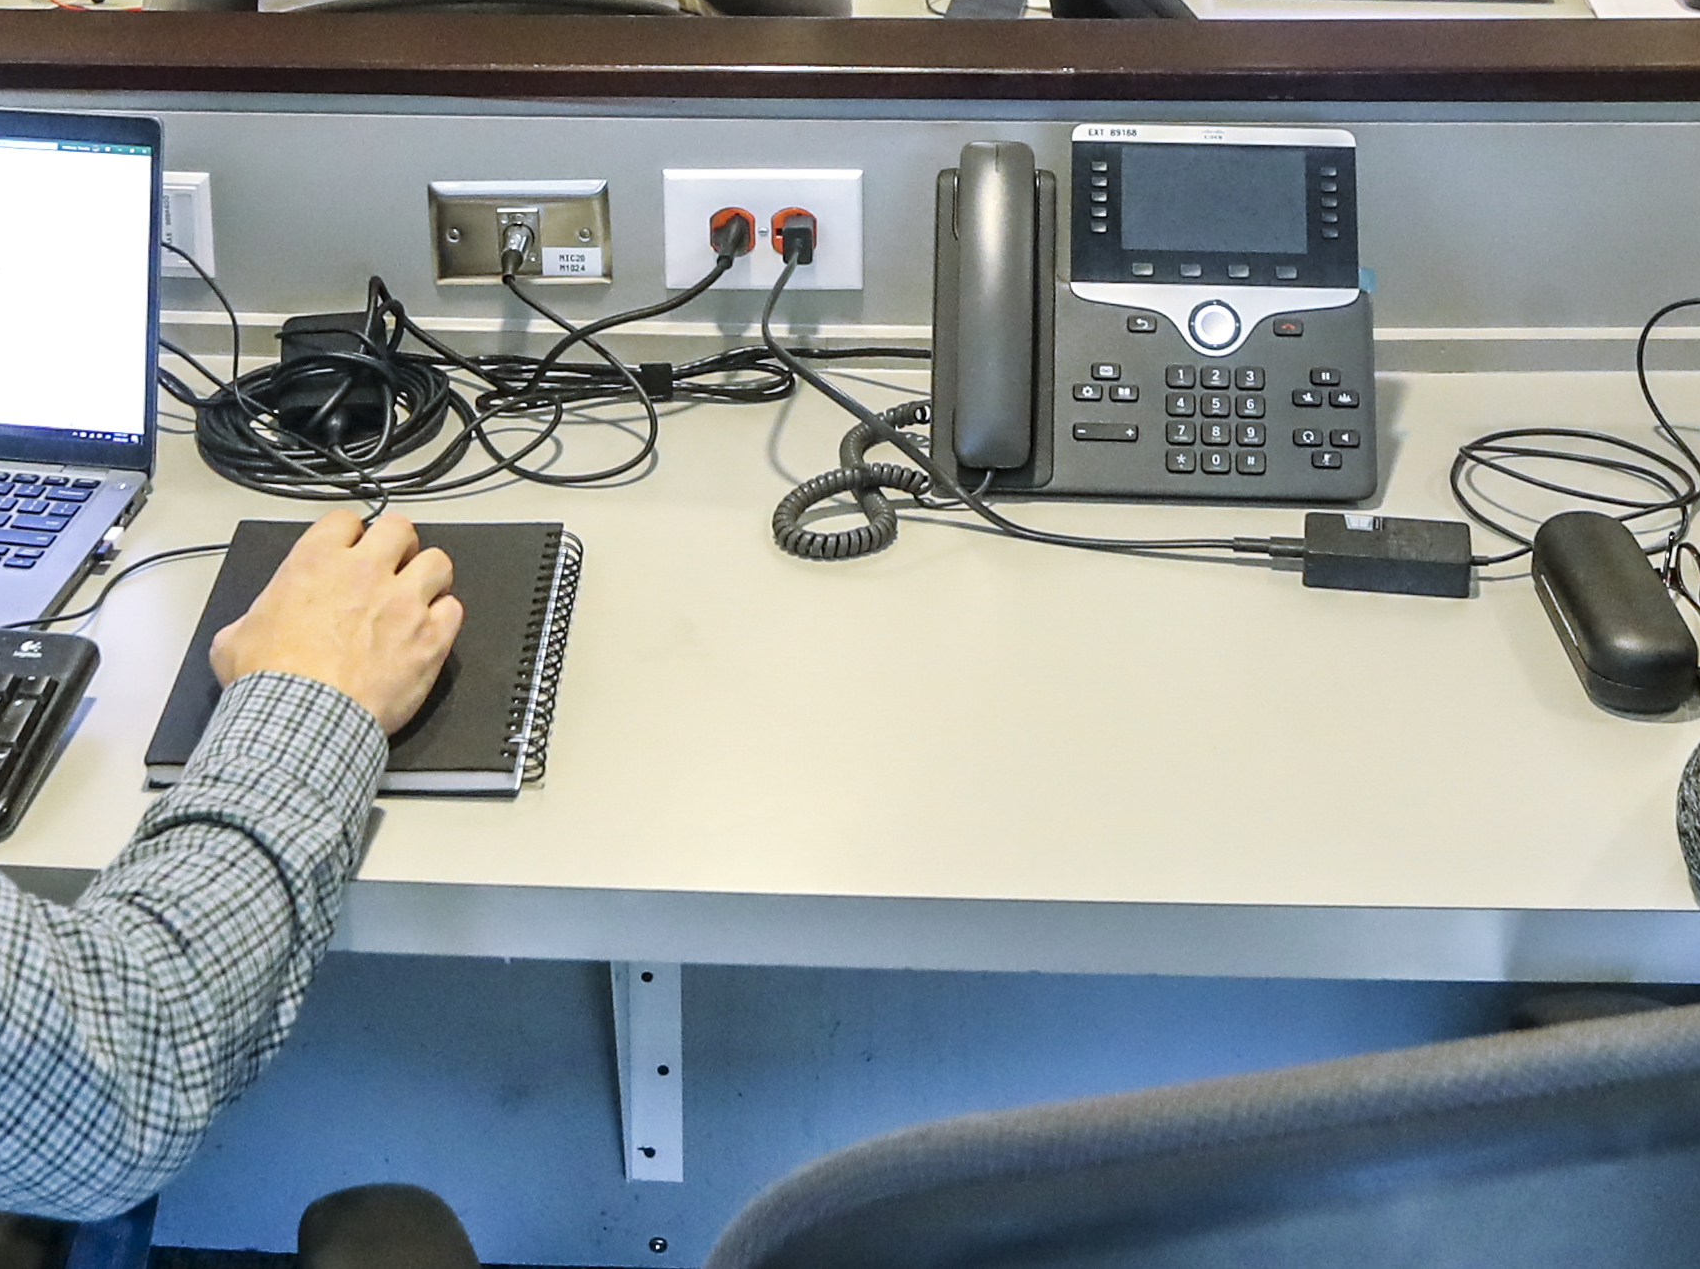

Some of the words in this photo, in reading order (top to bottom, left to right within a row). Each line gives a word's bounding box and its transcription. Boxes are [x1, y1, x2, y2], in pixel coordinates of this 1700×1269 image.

[1088, 128, 1104, 136] EXT
[559, 254, 586, 262] MIC20
[1177, 369, 1184, 380] 1
[1212, 369, 1220, 381] 2
[1246, 370, 1255, 382] 3
[1176, 397, 1185, 408] 4
[1212, 397, 1221, 409] 5
[1246, 398, 1255, 409] 6
[1177, 425, 1186, 436] 7
[1212, 425, 1221, 437] 8
[1246, 427, 1255, 438] 9
[1212, 454, 1221, 465] 0
